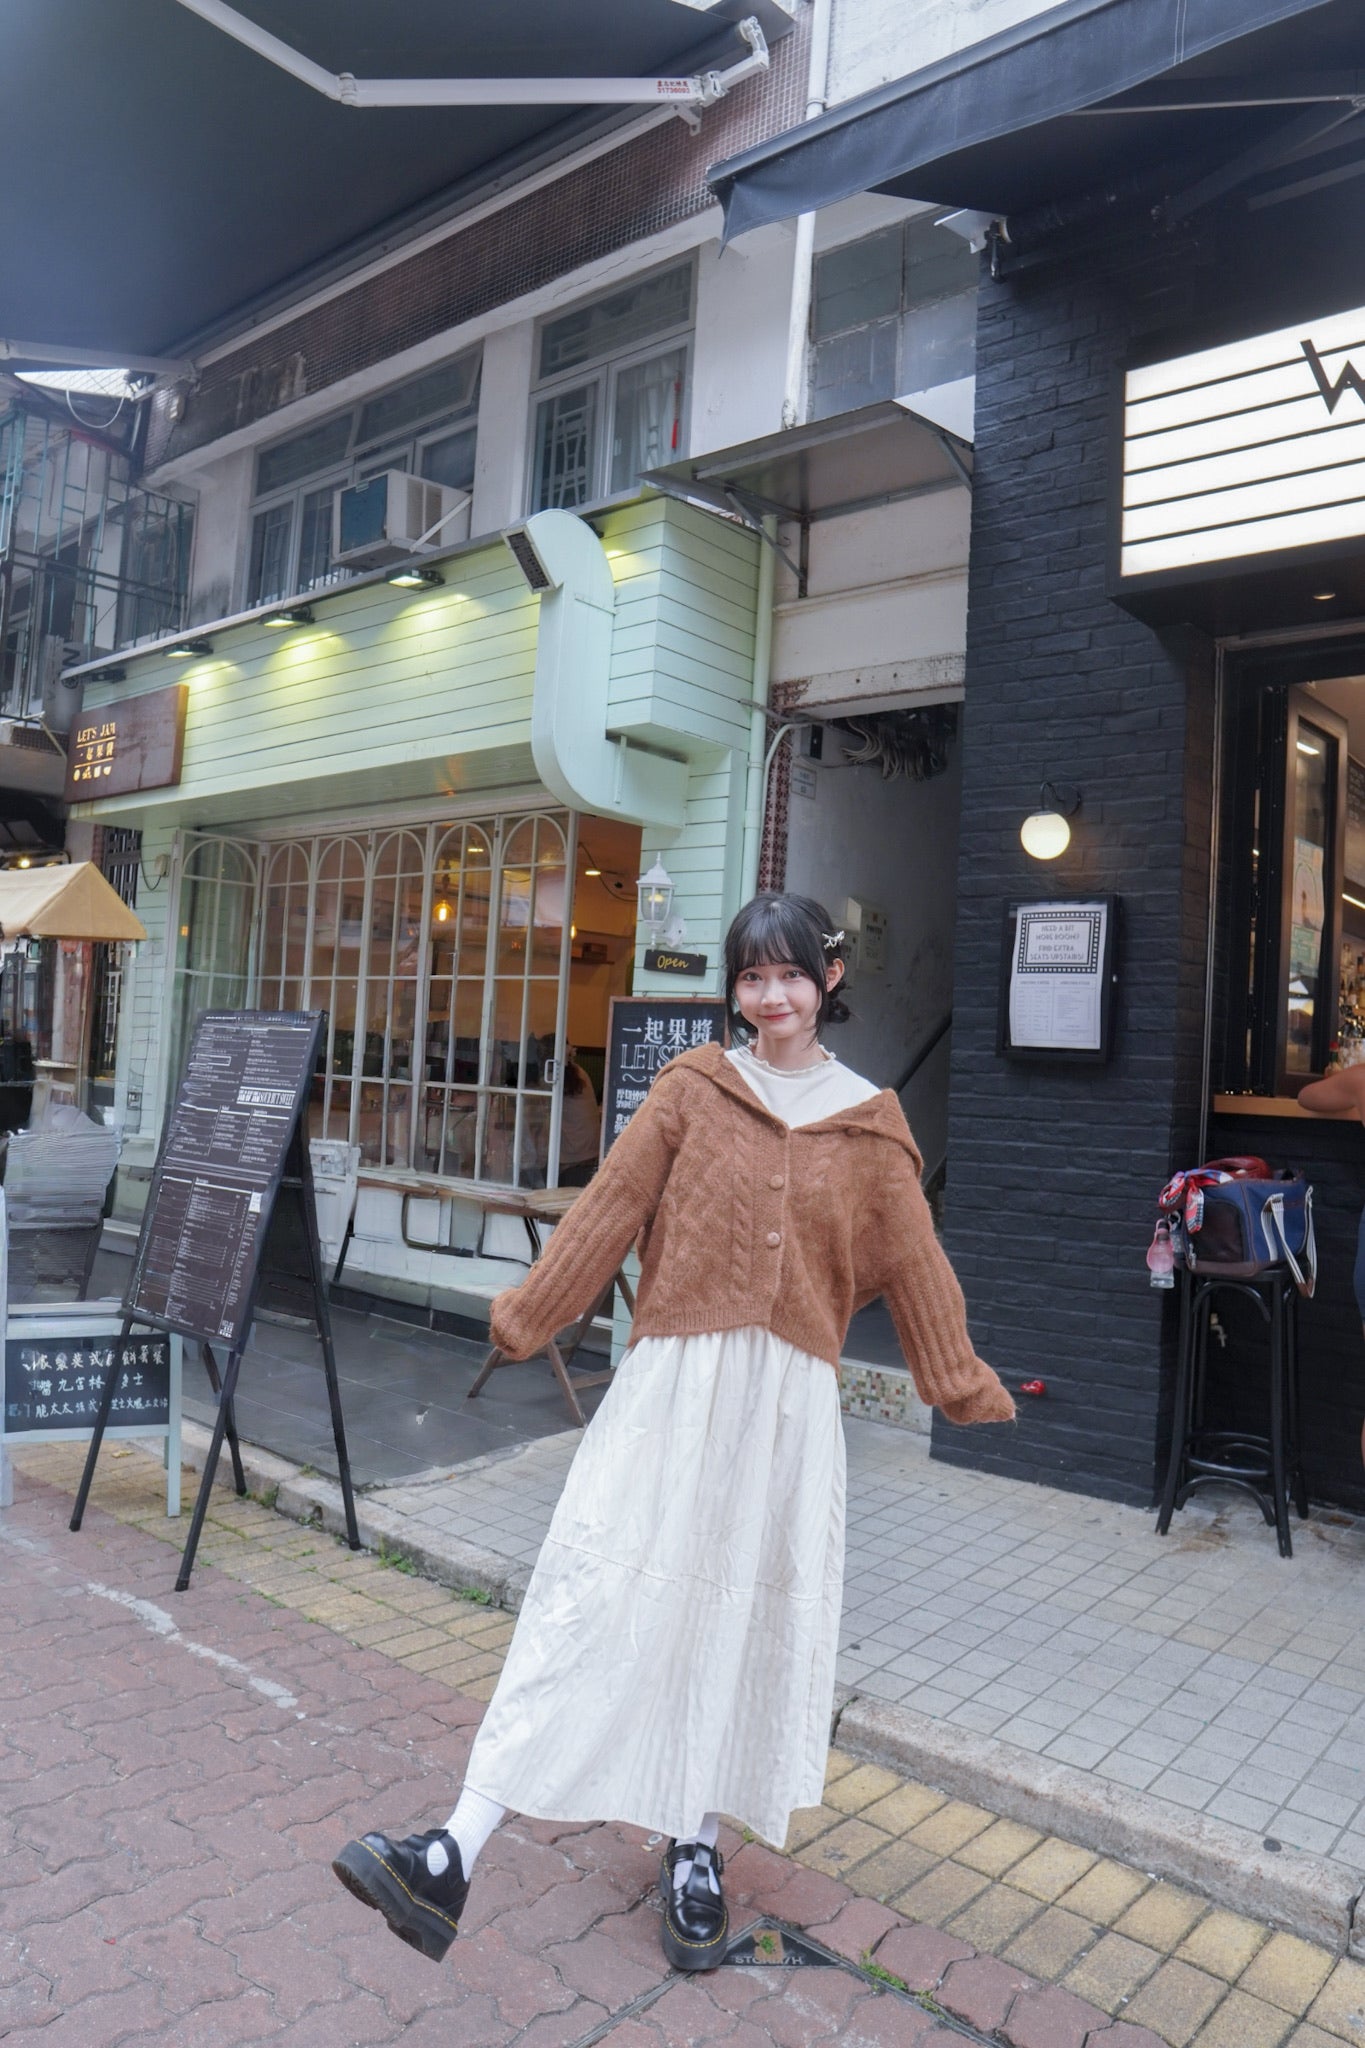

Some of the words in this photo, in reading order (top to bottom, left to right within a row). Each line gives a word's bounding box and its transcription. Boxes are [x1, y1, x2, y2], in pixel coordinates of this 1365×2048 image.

[1036, 933, 1054, 941] MORE
[1053, 944, 1075, 952] EXTRA
[1030, 953, 1049, 961] SEATS
[657, 955, 689, 970] Open
[622, 1016, 713, 1046] 一起果醬
